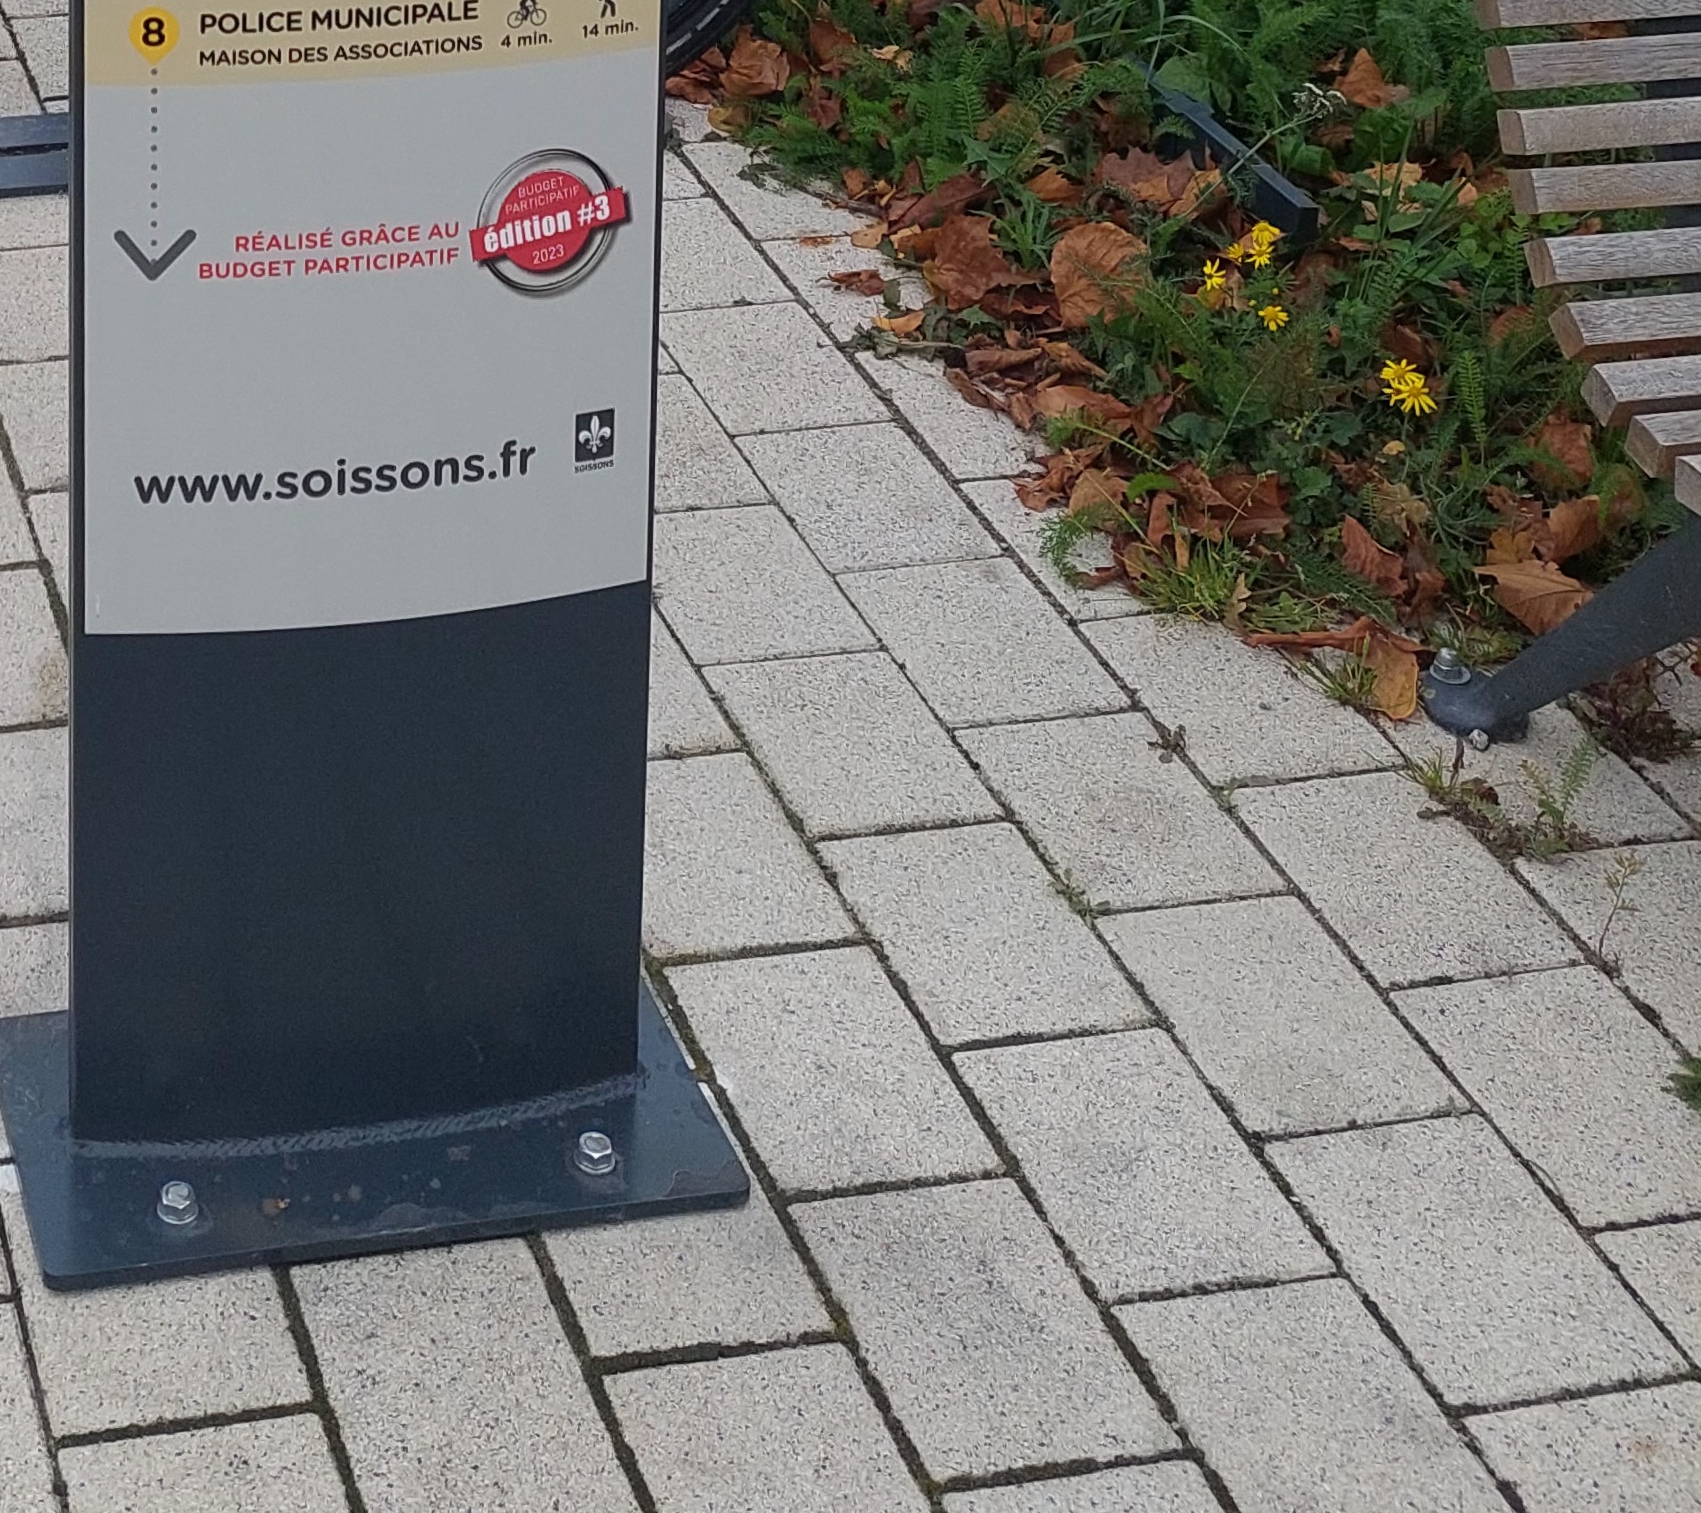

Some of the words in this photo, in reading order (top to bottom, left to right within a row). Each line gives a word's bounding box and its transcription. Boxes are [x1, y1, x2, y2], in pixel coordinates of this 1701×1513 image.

[141, 16, 166, 47] 8
[200, 10, 303, 35] POLICE
[311, 0, 480, 31] MUNICIPALE
[582, 24, 601, 39] 14
[605, 19, 640, 36] min.
[199, 47, 283, 67] MAISON
[288, 44, 328, 64] DES
[332, 35, 483, 62] ASSOCIATIONS
[501, 34, 512, 49] 4
[515, 30, 553, 47] min.
[504, 185, 581, 215] PARTICIPATIF
[517, 176, 565, 199] BUDGET
[234, 229, 334, 253] RÉALISÉ
[341, 223, 421, 247] GRÂCE
[427, 222, 460, 241] AU
[483, 211, 573, 254] édition
[576, 194, 611, 228] #3
[199, 258, 296, 280] BUDGET
[304, 247, 461, 275] PARTICIPATIF
[532, 244, 565, 266] 2023
[133, 440, 537, 505] www.soissons.fr
[574, 458, 615, 473] SOISSONS
